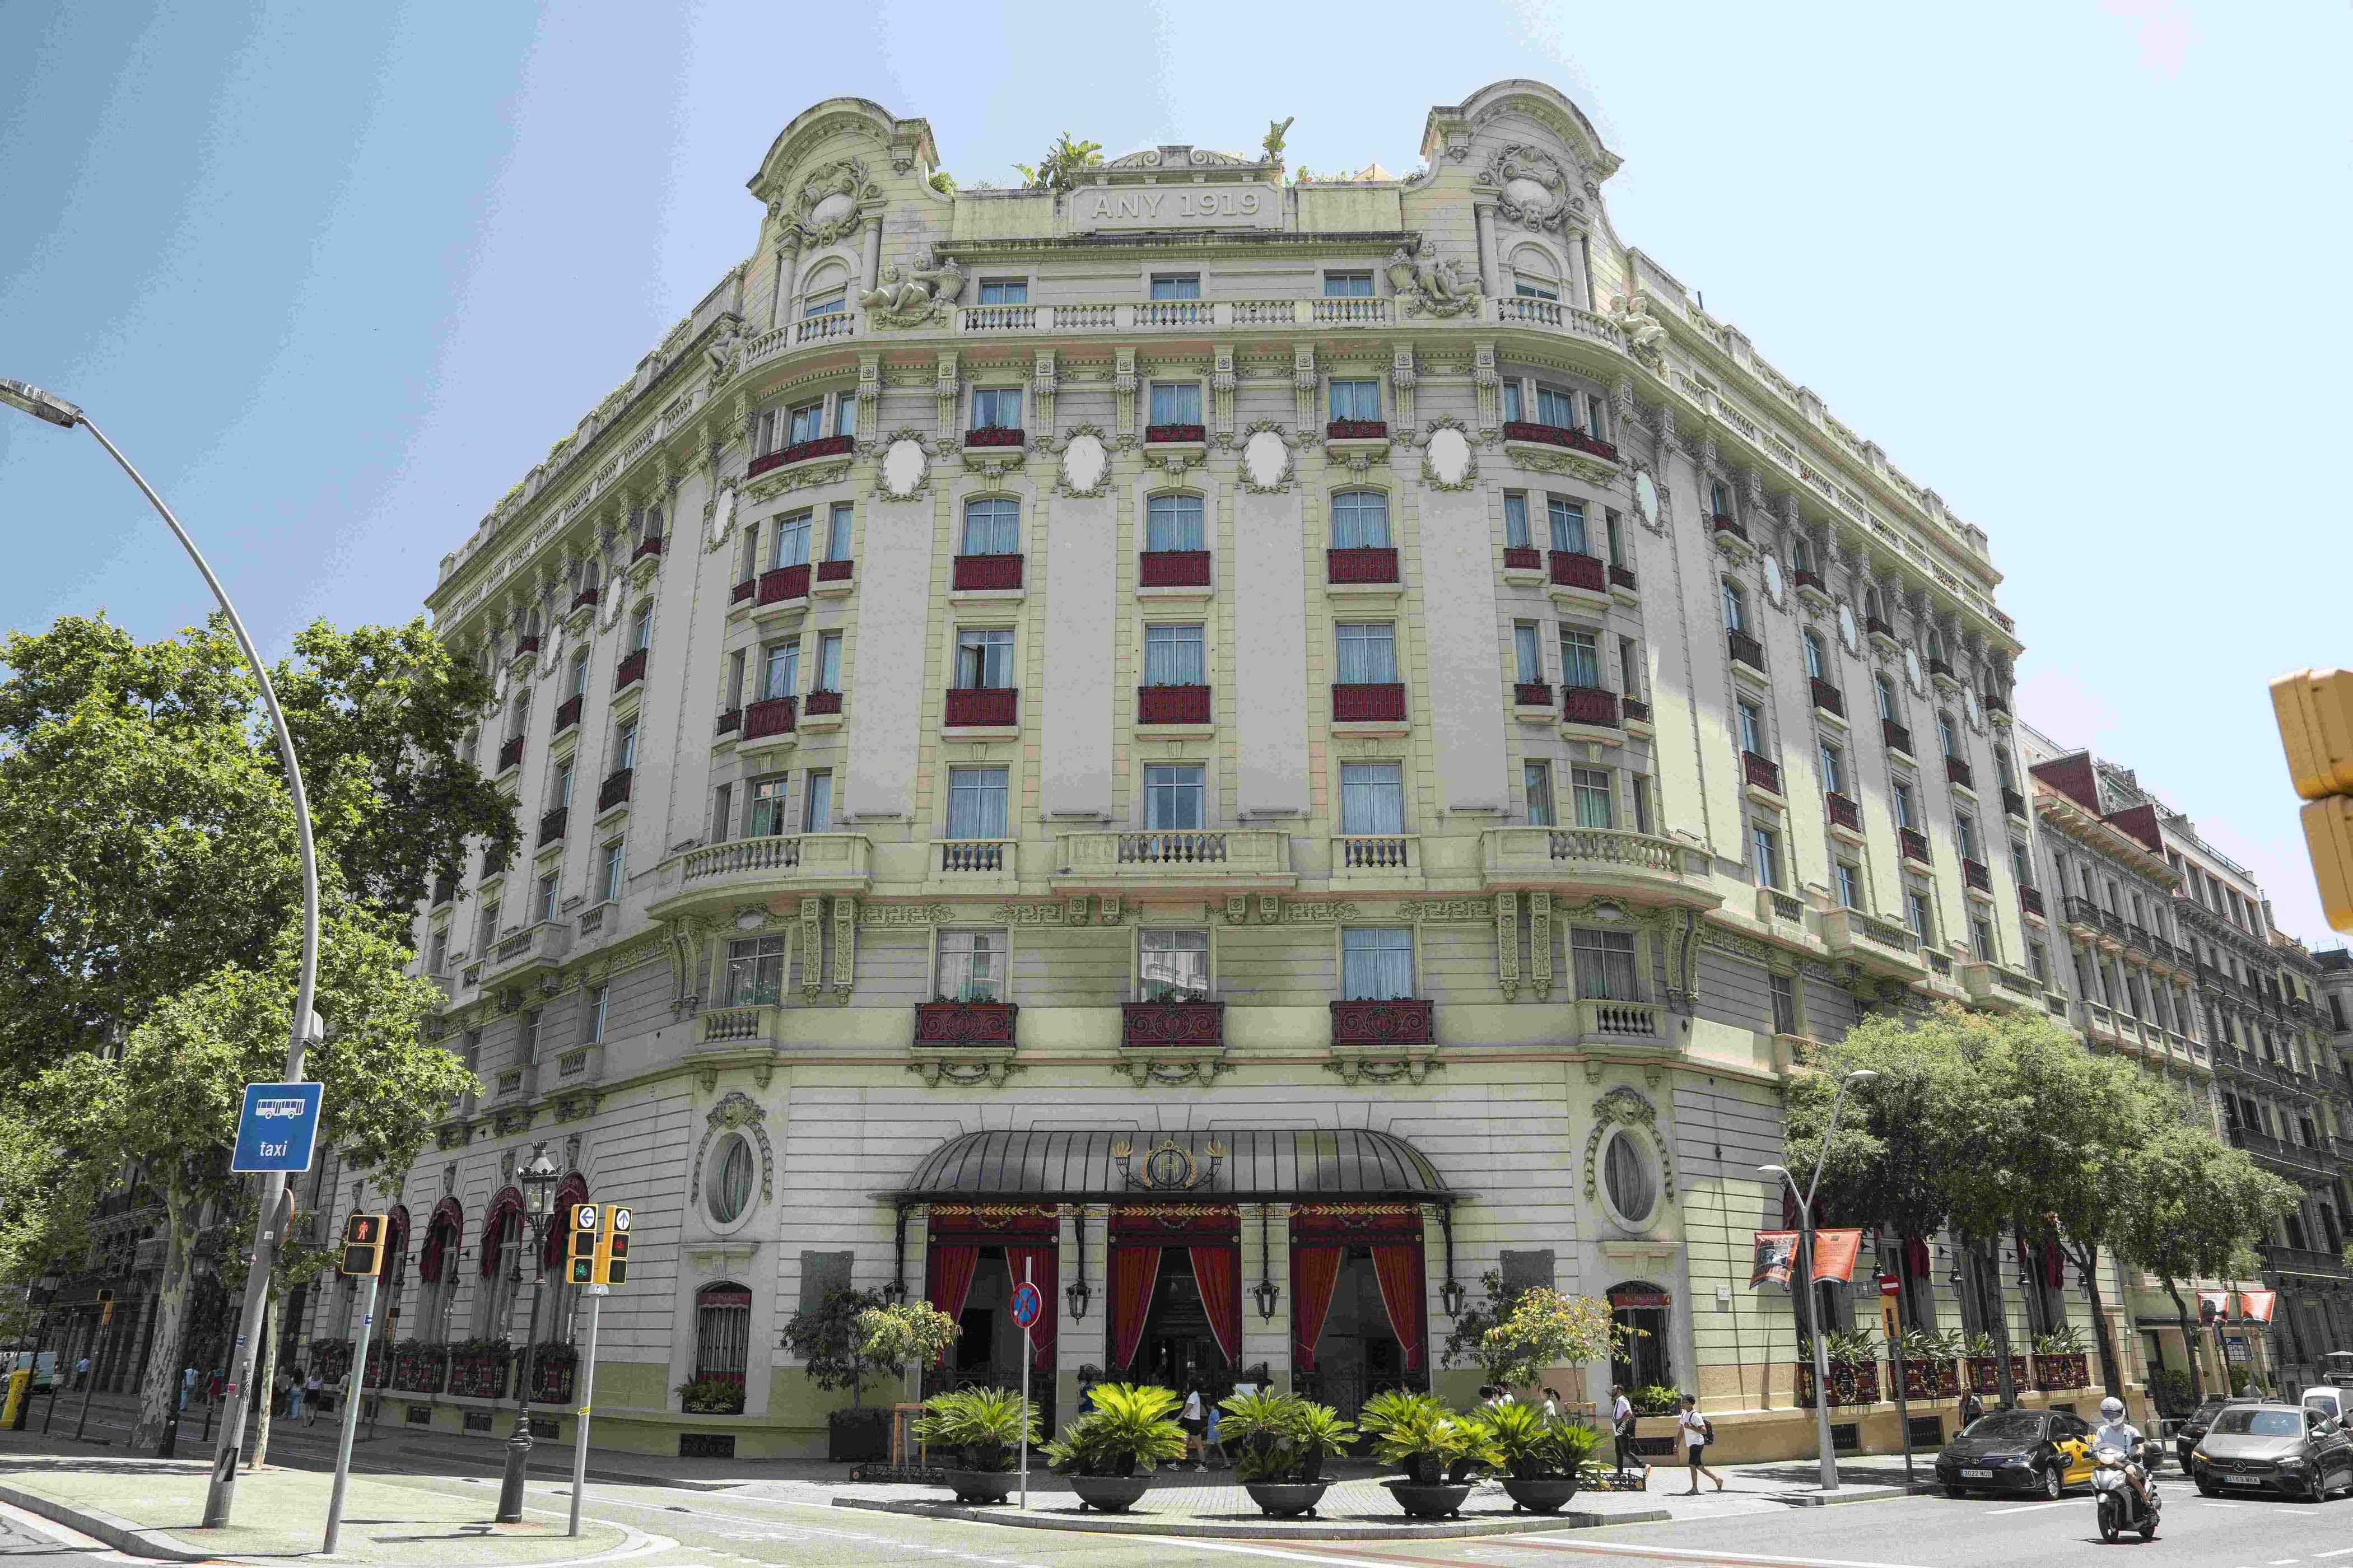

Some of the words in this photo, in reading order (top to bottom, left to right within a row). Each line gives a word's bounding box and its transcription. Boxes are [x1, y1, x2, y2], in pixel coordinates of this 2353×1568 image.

[1092, 194, 1164, 218] ANY
[1180, 192, 1260, 216] 1919
[260, 1140, 287, 1156] taxi
